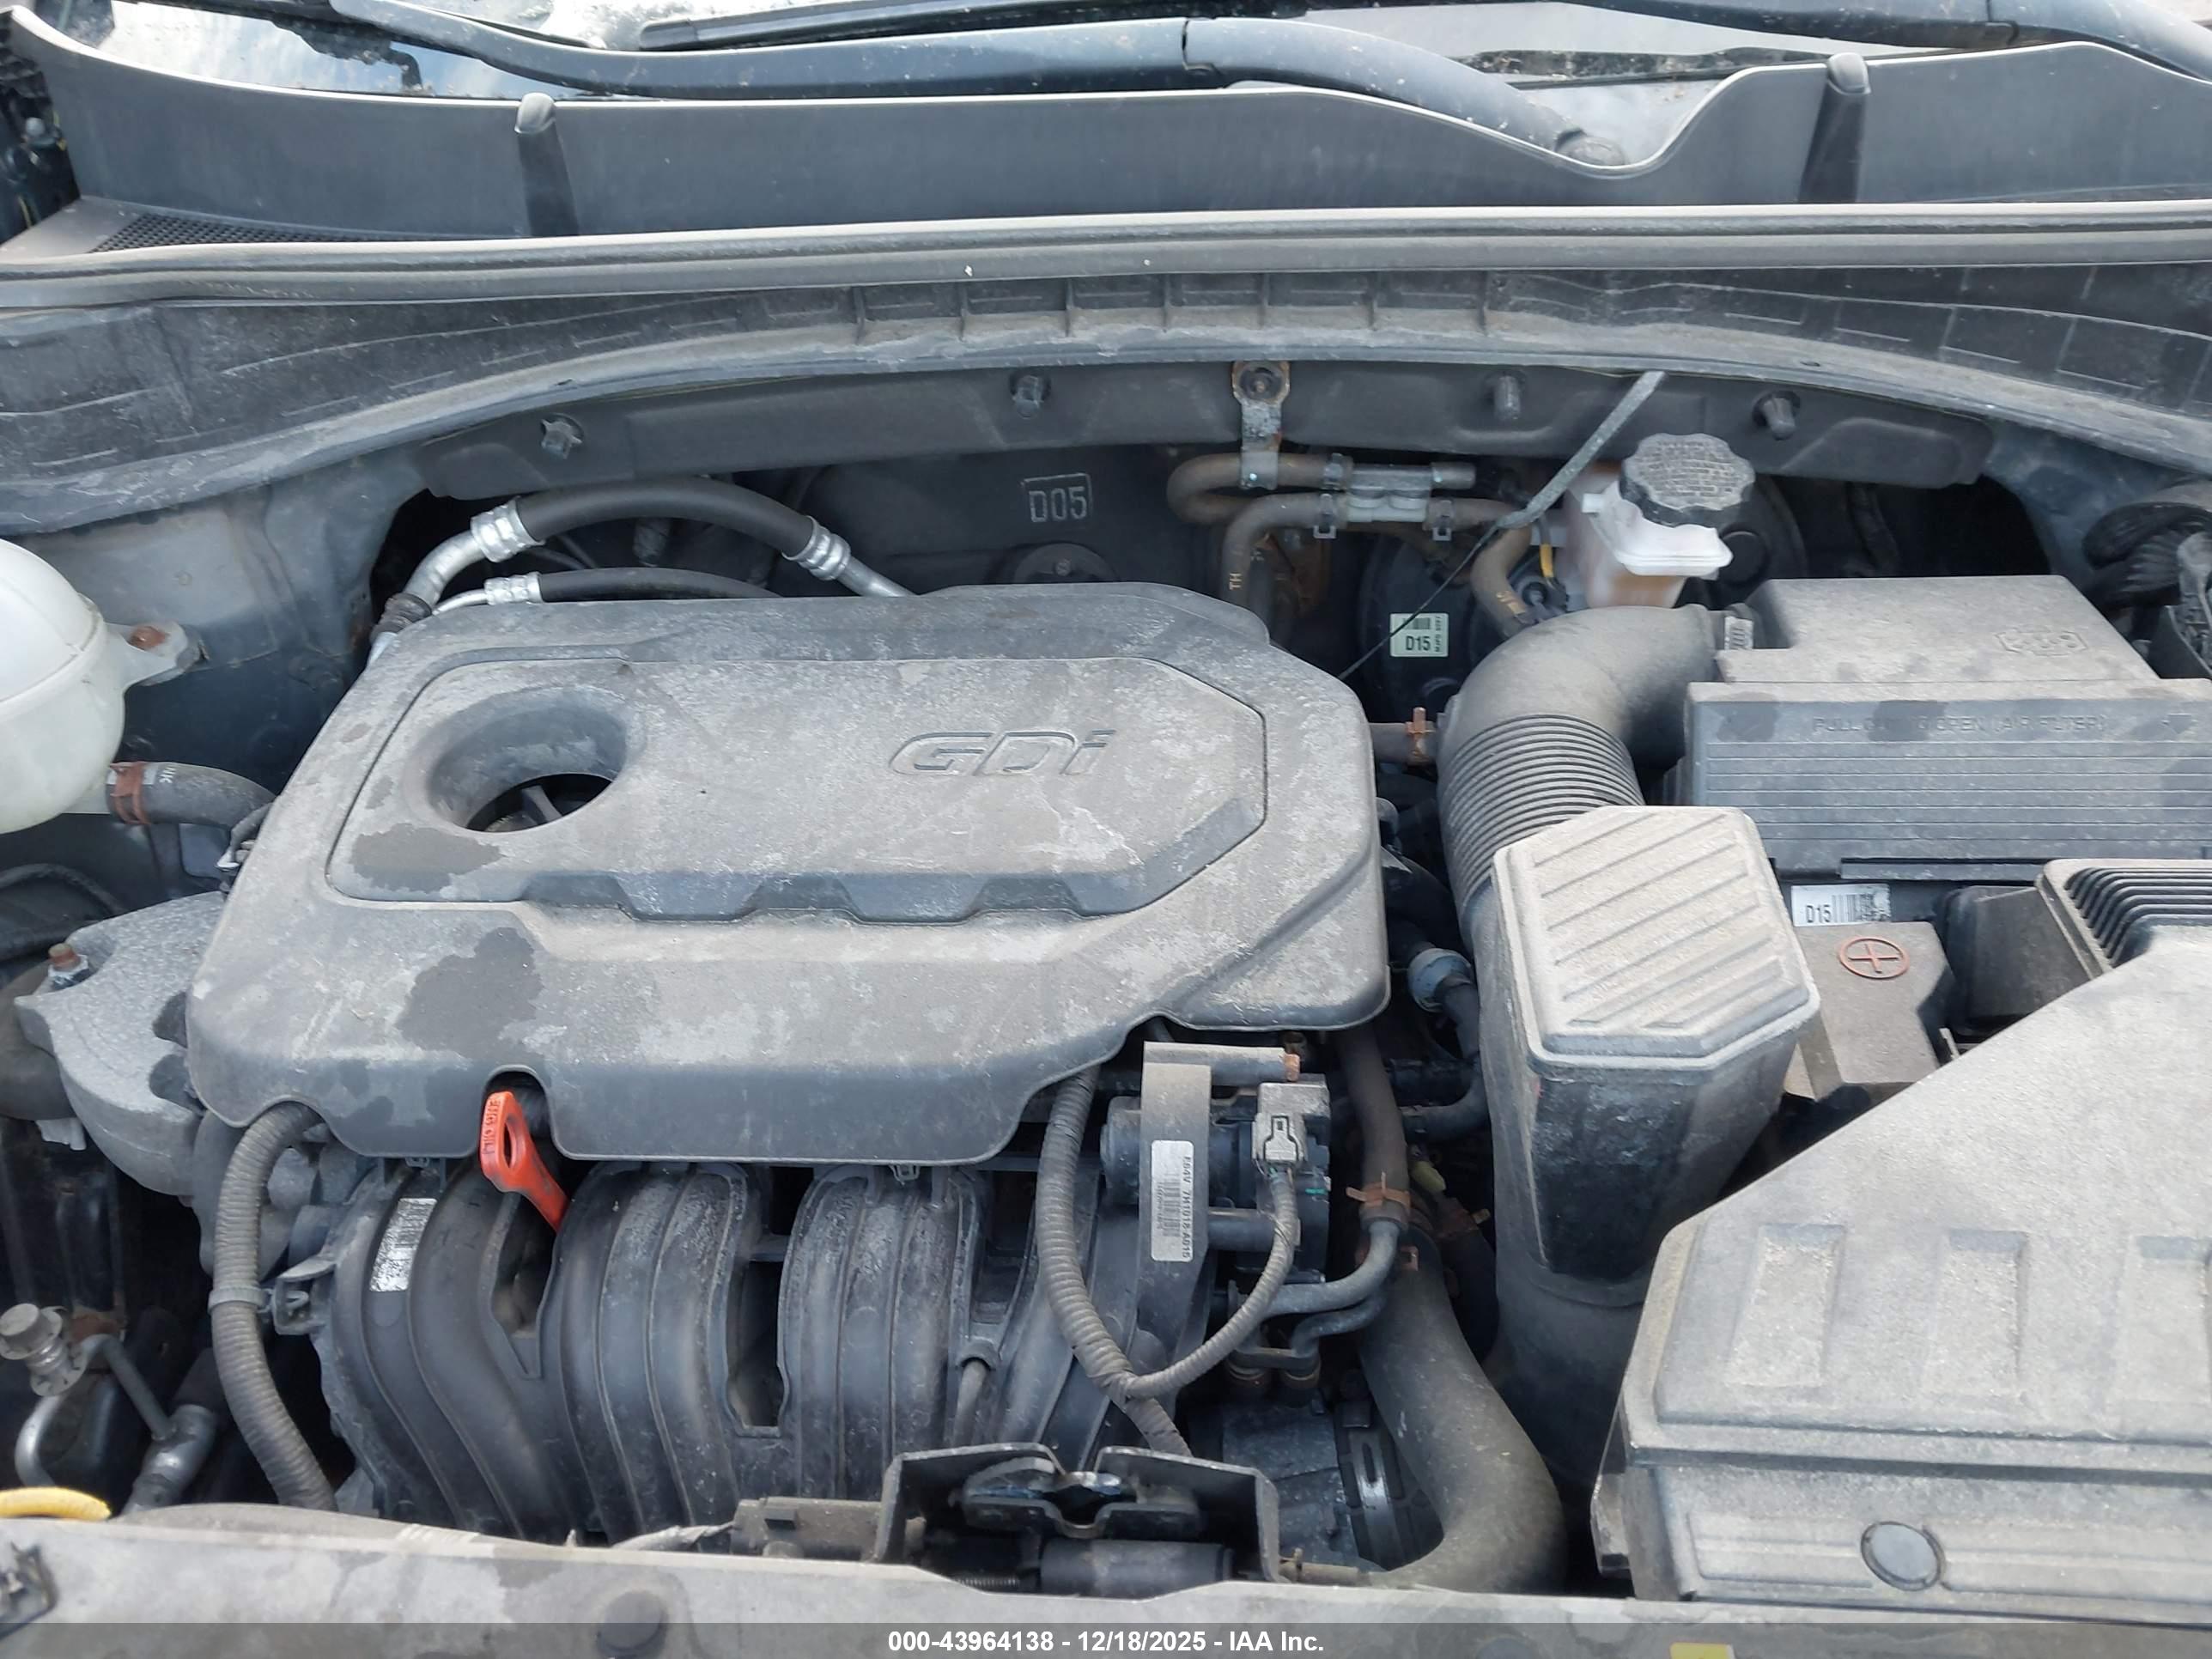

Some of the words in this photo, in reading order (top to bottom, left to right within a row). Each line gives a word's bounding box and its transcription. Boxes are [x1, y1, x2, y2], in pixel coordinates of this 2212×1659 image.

[1028, 486, 1088, 523] D05
[1405, 635, 1431, 651] D15
[889, 729, 1117, 776] GDi
[1804, 903, 1832, 923] D15
